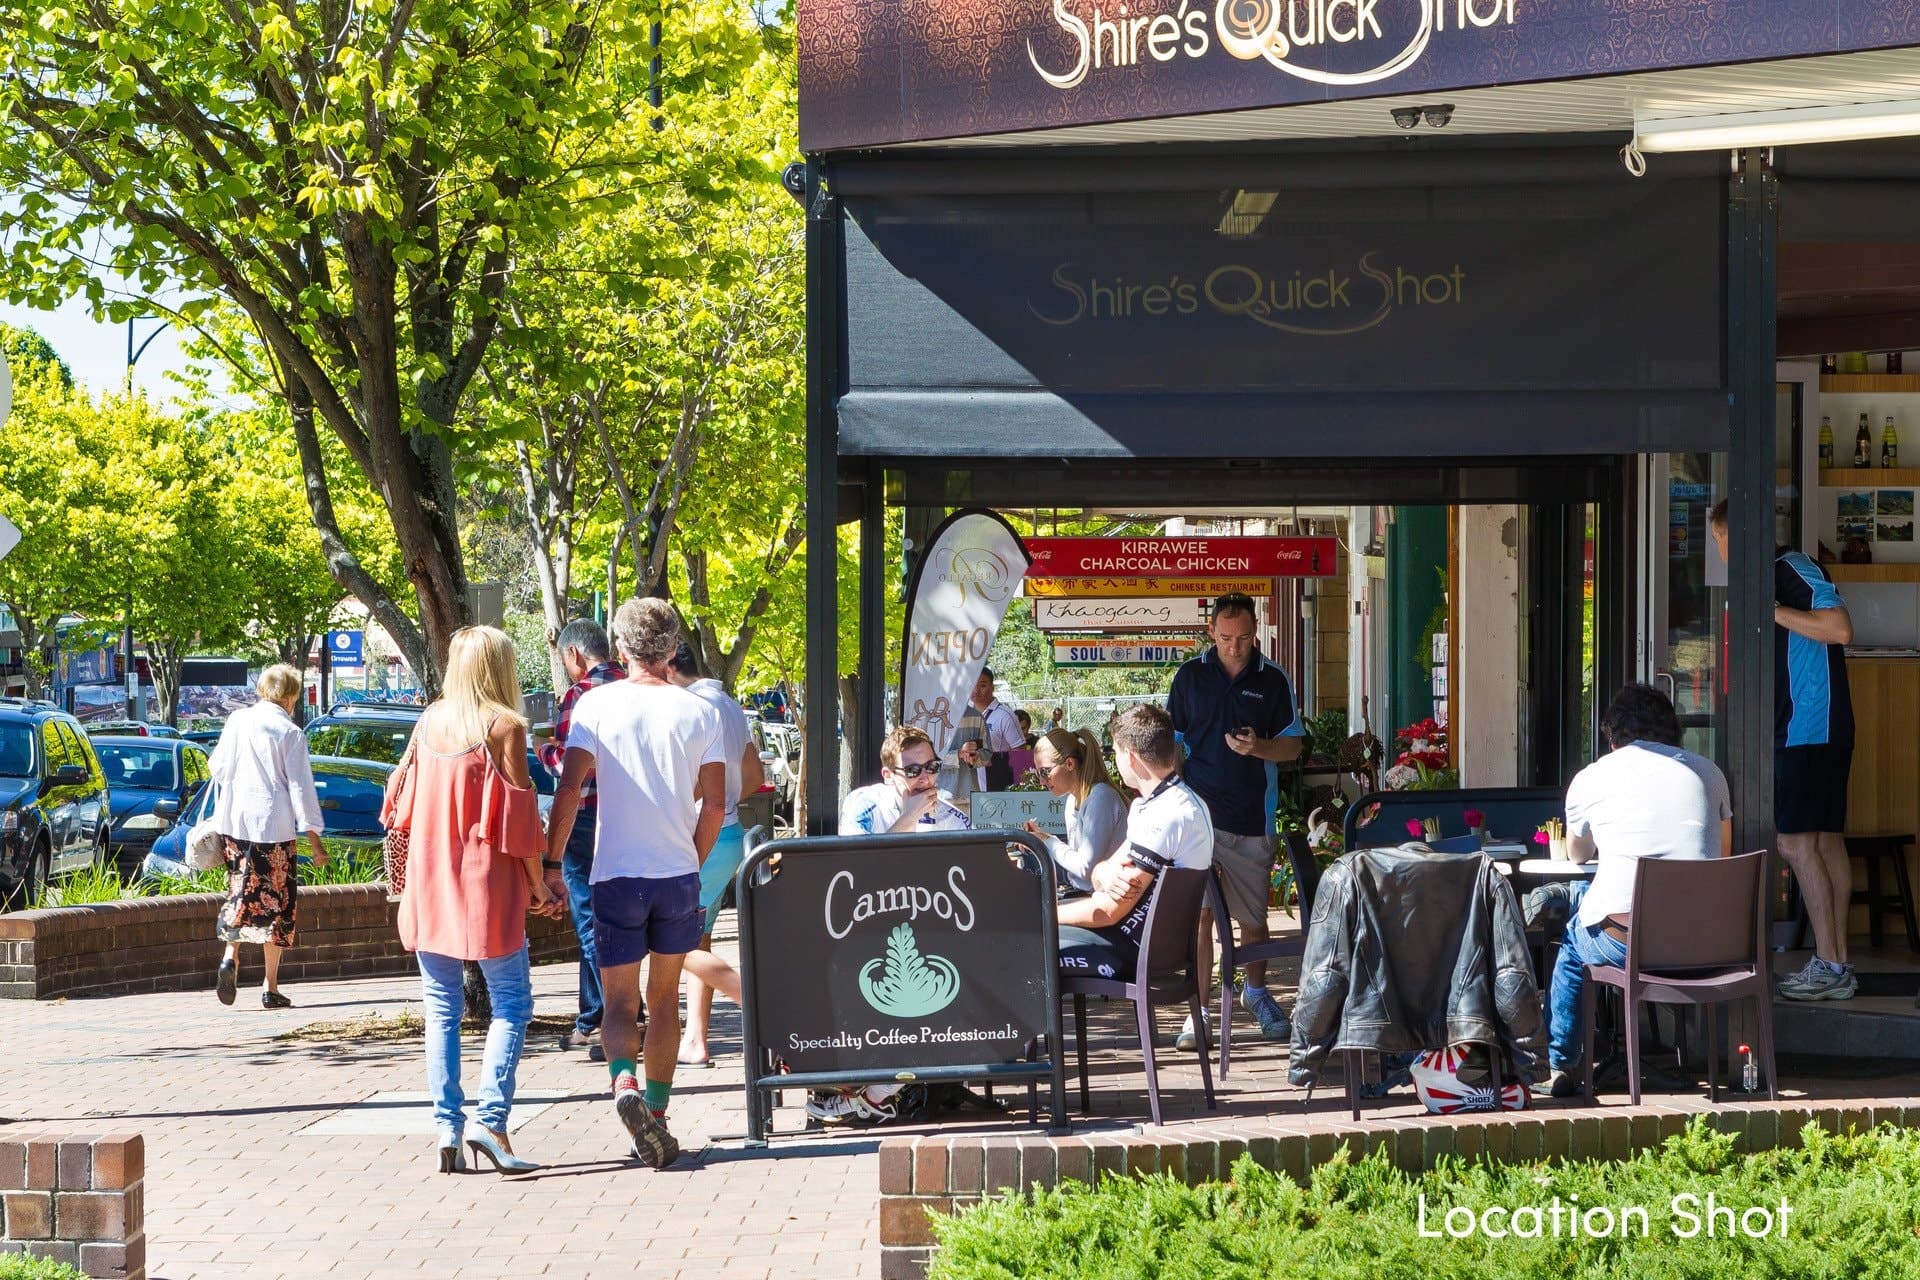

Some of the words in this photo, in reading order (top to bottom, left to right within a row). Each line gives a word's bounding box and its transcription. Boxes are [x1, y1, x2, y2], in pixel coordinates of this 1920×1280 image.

[1027, 0, 1209, 88] Shire's
[1215, 0, 1386, 68] Quick
[1028, 263, 1199, 325] Shire's
[1204, 265, 1352, 322] Quick
[1358, 251, 1466, 322] Shot
[1121, 541, 1208, 554] KIRRAWEE
[1080, 557, 1171, 571] CHARCOAL
[1176, 557, 1249, 570] CHICKEN
[1170, 583, 1206, 592] CHINESE
[1210, 583, 1266, 592] RESTAURANT
[1047, 602, 1171, 622] Khaogang
[1070, 647, 1106, 661] SOUL
[1139, 647, 1178, 661] INDIA
[789, 1032, 862, 1053] Specialty
[865, 1028, 918, 1047] Coffee
[920, 1024, 1018, 1043] Professionals
[1466, 1095, 1490, 1104] SHOEI
